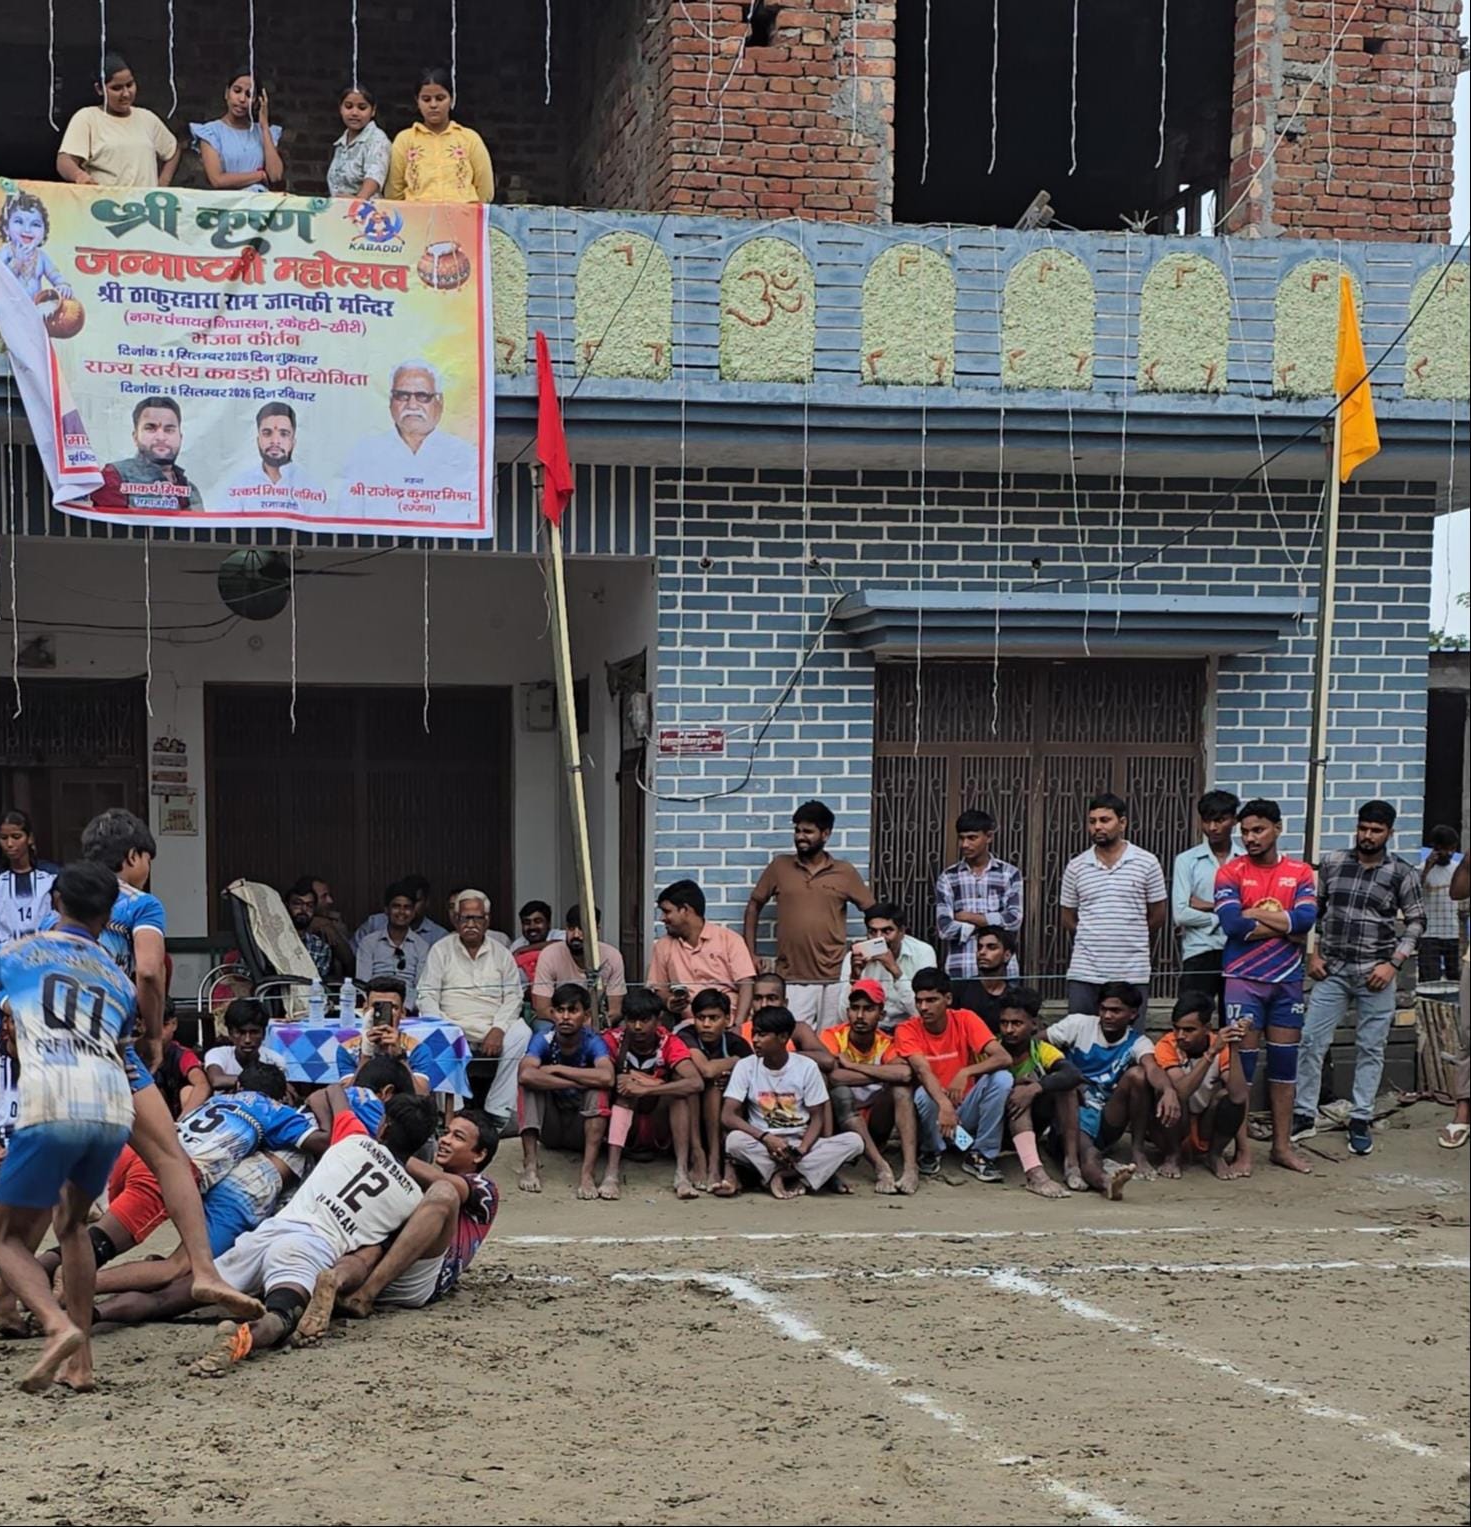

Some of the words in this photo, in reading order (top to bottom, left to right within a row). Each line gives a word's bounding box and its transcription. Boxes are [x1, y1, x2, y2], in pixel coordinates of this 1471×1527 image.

[90, 191, 181, 241] श्री
[196, 206, 318, 254] कृष्ण
[349, 243, 403, 253] KABADDI
[75, 246, 266, 285] जन्माष्टमी
[274, 250, 410, 292] महोत्सव
[97, 283, 124, 303] श्री
[129, 287, 219, 312] ठाकुरद्वारा
[224, 292, 258, 310] राम
[264, 292, 332, 313] जानकी
[337, 295, 394, 317] मन्दिर
[124, 310, 162, 325] (नगर
[164, 312, 211, 329] पंचायत
[192, 332, 242, 346] भजन
[247, 331, 301, 347] कीर्तन
[177, 347, 226, 362] सितम्बर
[226, 351, 249, 361] 2026
[250, 350, 274, 363] दिन
[84, 359, 133, 376] राज्य
[139, 362, 199, 379] स्तरीय
[276, 366, 368, 386] प्रतियोगिता
[179, 384, 228, 398] सितम्बर
[229, 387, 251, 398] 2026
[253, 386, 275, 400] दिन
[277, 387, 316, 401] रविवार
[350, 482, 365, 496] श्री
[407, 488, 440, 504] कुमार
[441, 487, 471, 501] मिश्रा
[17, 907, 32, 921] 14
[1226, 1004, 1242, 1019] 07
[336, 1161, 390, 1214] 12
